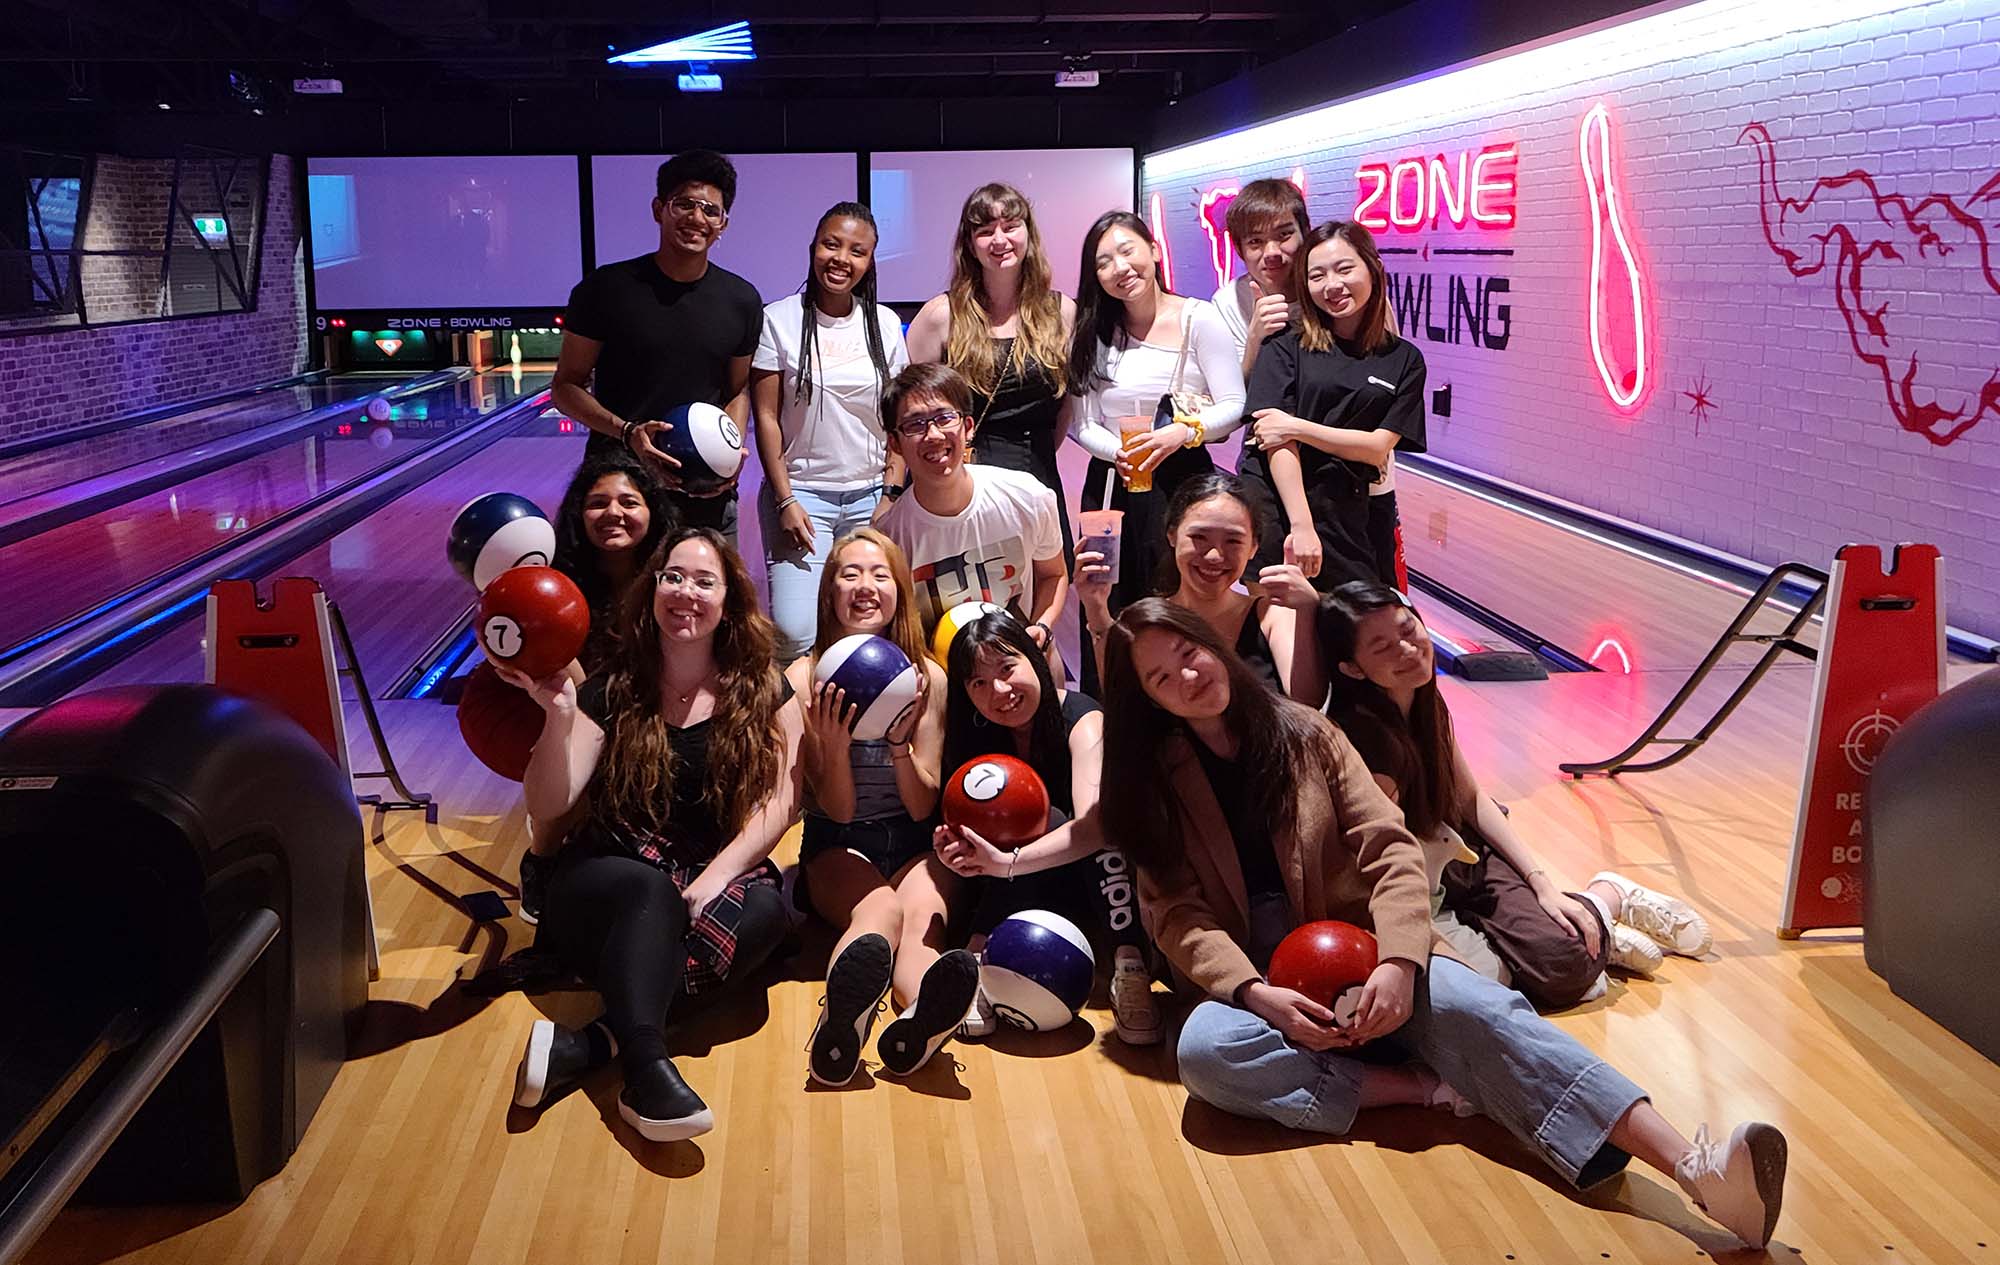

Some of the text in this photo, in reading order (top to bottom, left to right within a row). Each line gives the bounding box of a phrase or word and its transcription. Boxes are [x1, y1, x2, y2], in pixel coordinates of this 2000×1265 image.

[1353, 143, 1517, 233] ZONE
[386, 316, 512, 328] ZONE BOWLING
[1385, 272, 1511, 351] WLING
[315, 316, 327, 331] 9
[725, 421, 740, 443] 10
[492, 625, 507, 648] 7
[974, 768, 996, 789] 7
[1836, 793, 1862, 811] RE
[1848, 818, 1863, 837] A
[1832, 845, 1864, 864] BO
[1095, 851, 1133, 932] adid
